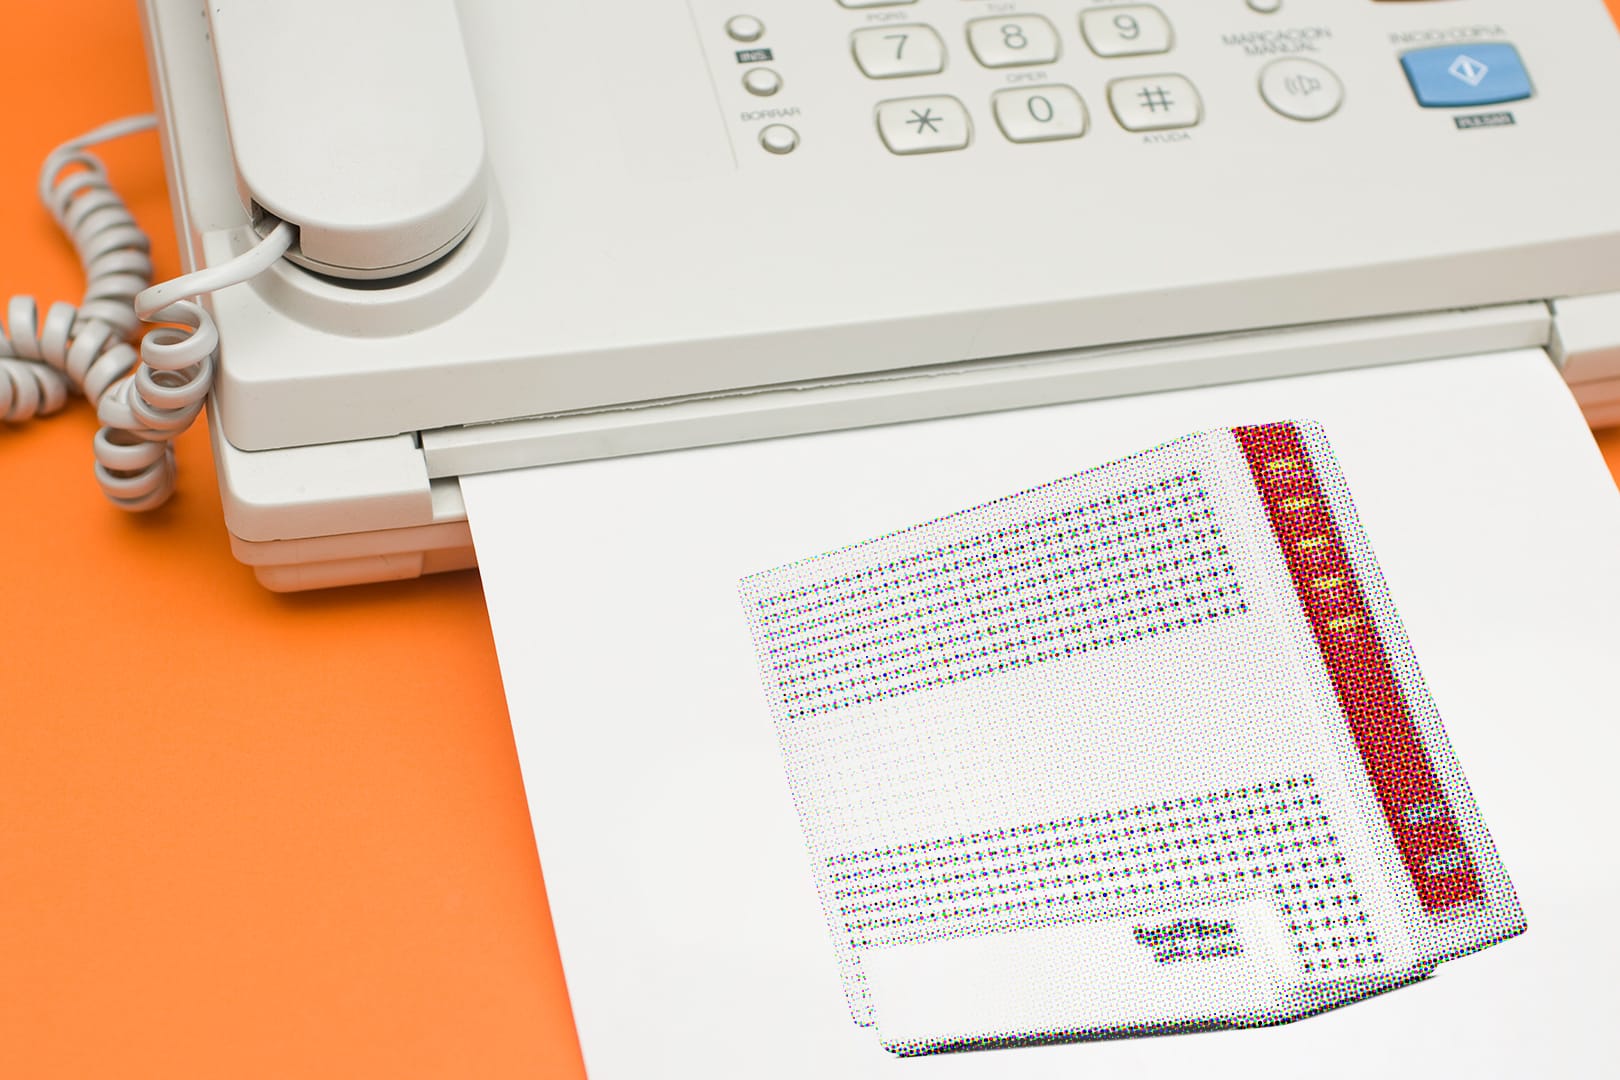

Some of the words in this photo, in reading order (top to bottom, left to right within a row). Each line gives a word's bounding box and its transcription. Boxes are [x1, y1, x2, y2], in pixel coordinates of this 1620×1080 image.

[1000, 24, 1028, 50] 8
[1113, 14, 1140, 40] 9
[884, 34, 909, 60] 7
[1027, 95, 1054, 123] 0
[1137, 86, 1174, 112] #
[741, 106, 801, 121] BORRAR
[1142, 131, 1192, 144] AYUDA
